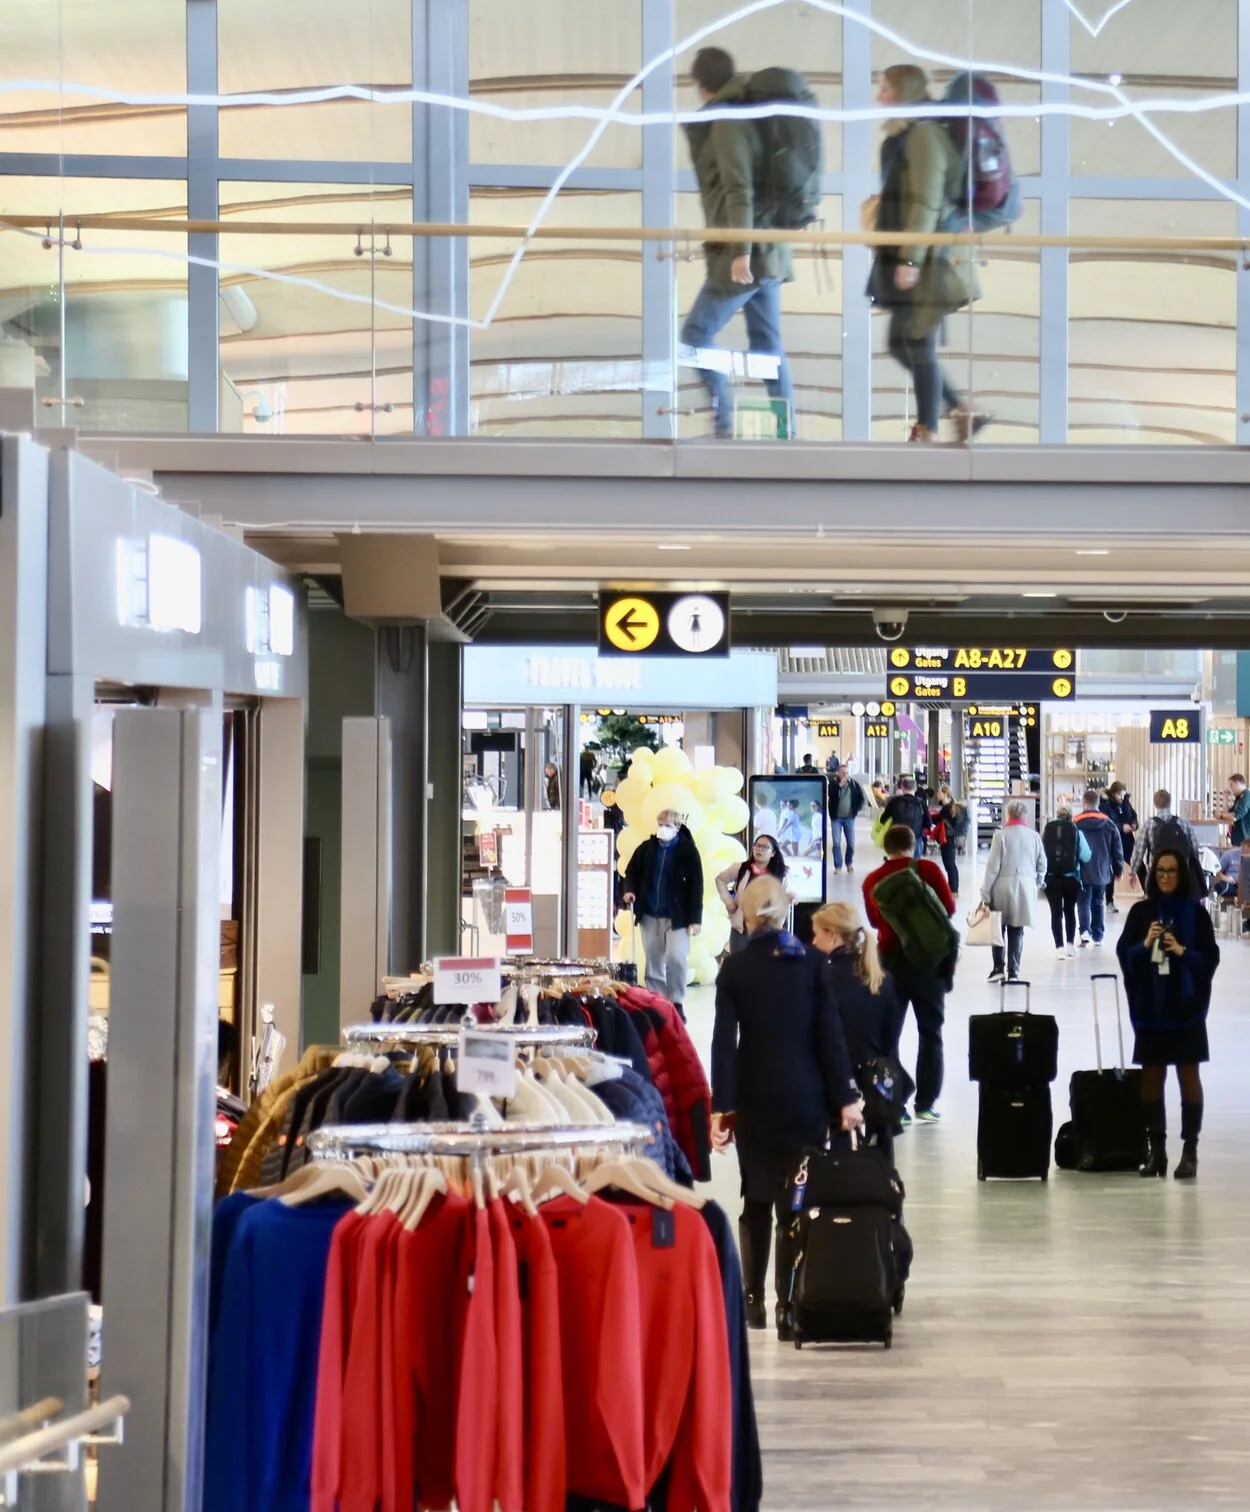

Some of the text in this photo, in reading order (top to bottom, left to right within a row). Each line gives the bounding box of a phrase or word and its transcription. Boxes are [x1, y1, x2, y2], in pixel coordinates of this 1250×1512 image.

[914, 647, 949, 660] Utgang
[954, 649, 1027, 669] A8-A27
[915, 657, 942, 668] Gates
[914, 676, 948, 688] Utgang
[953, 677, 966, 697] B
[915, 686, 941, 697] Gates
[820, 725, 838, 737] A14
[866, 725, 888, 737] A12
[972, 721, 1000, 737] A10
[1161, 718, 1189, 739] A8
